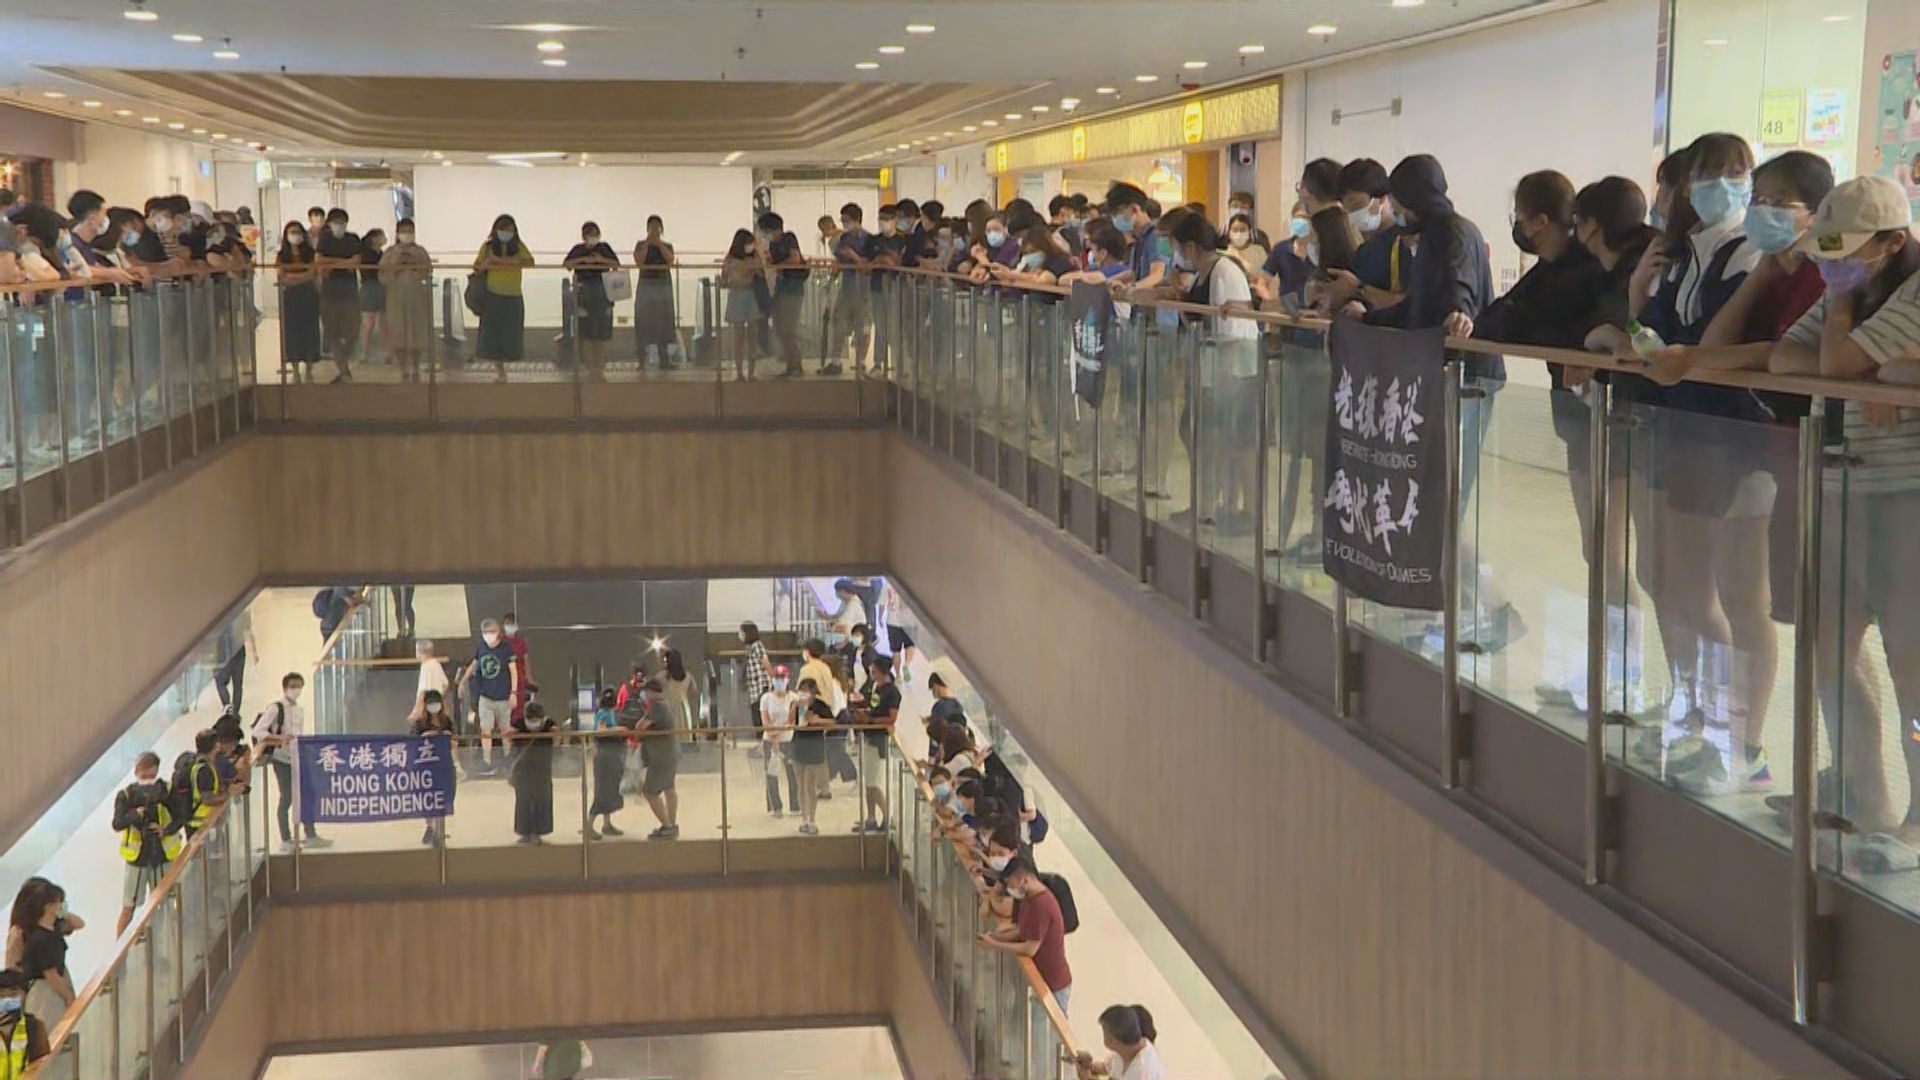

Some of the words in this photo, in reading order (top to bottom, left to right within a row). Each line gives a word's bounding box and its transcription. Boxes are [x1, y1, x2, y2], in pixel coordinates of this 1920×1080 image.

[317, 739, 440, 773] 香港獨立
[331, 774, 380, 794] HONG
[386, 770, 433, 792] KONG
[320, 790, 445, 816] INDEPENDENCE
